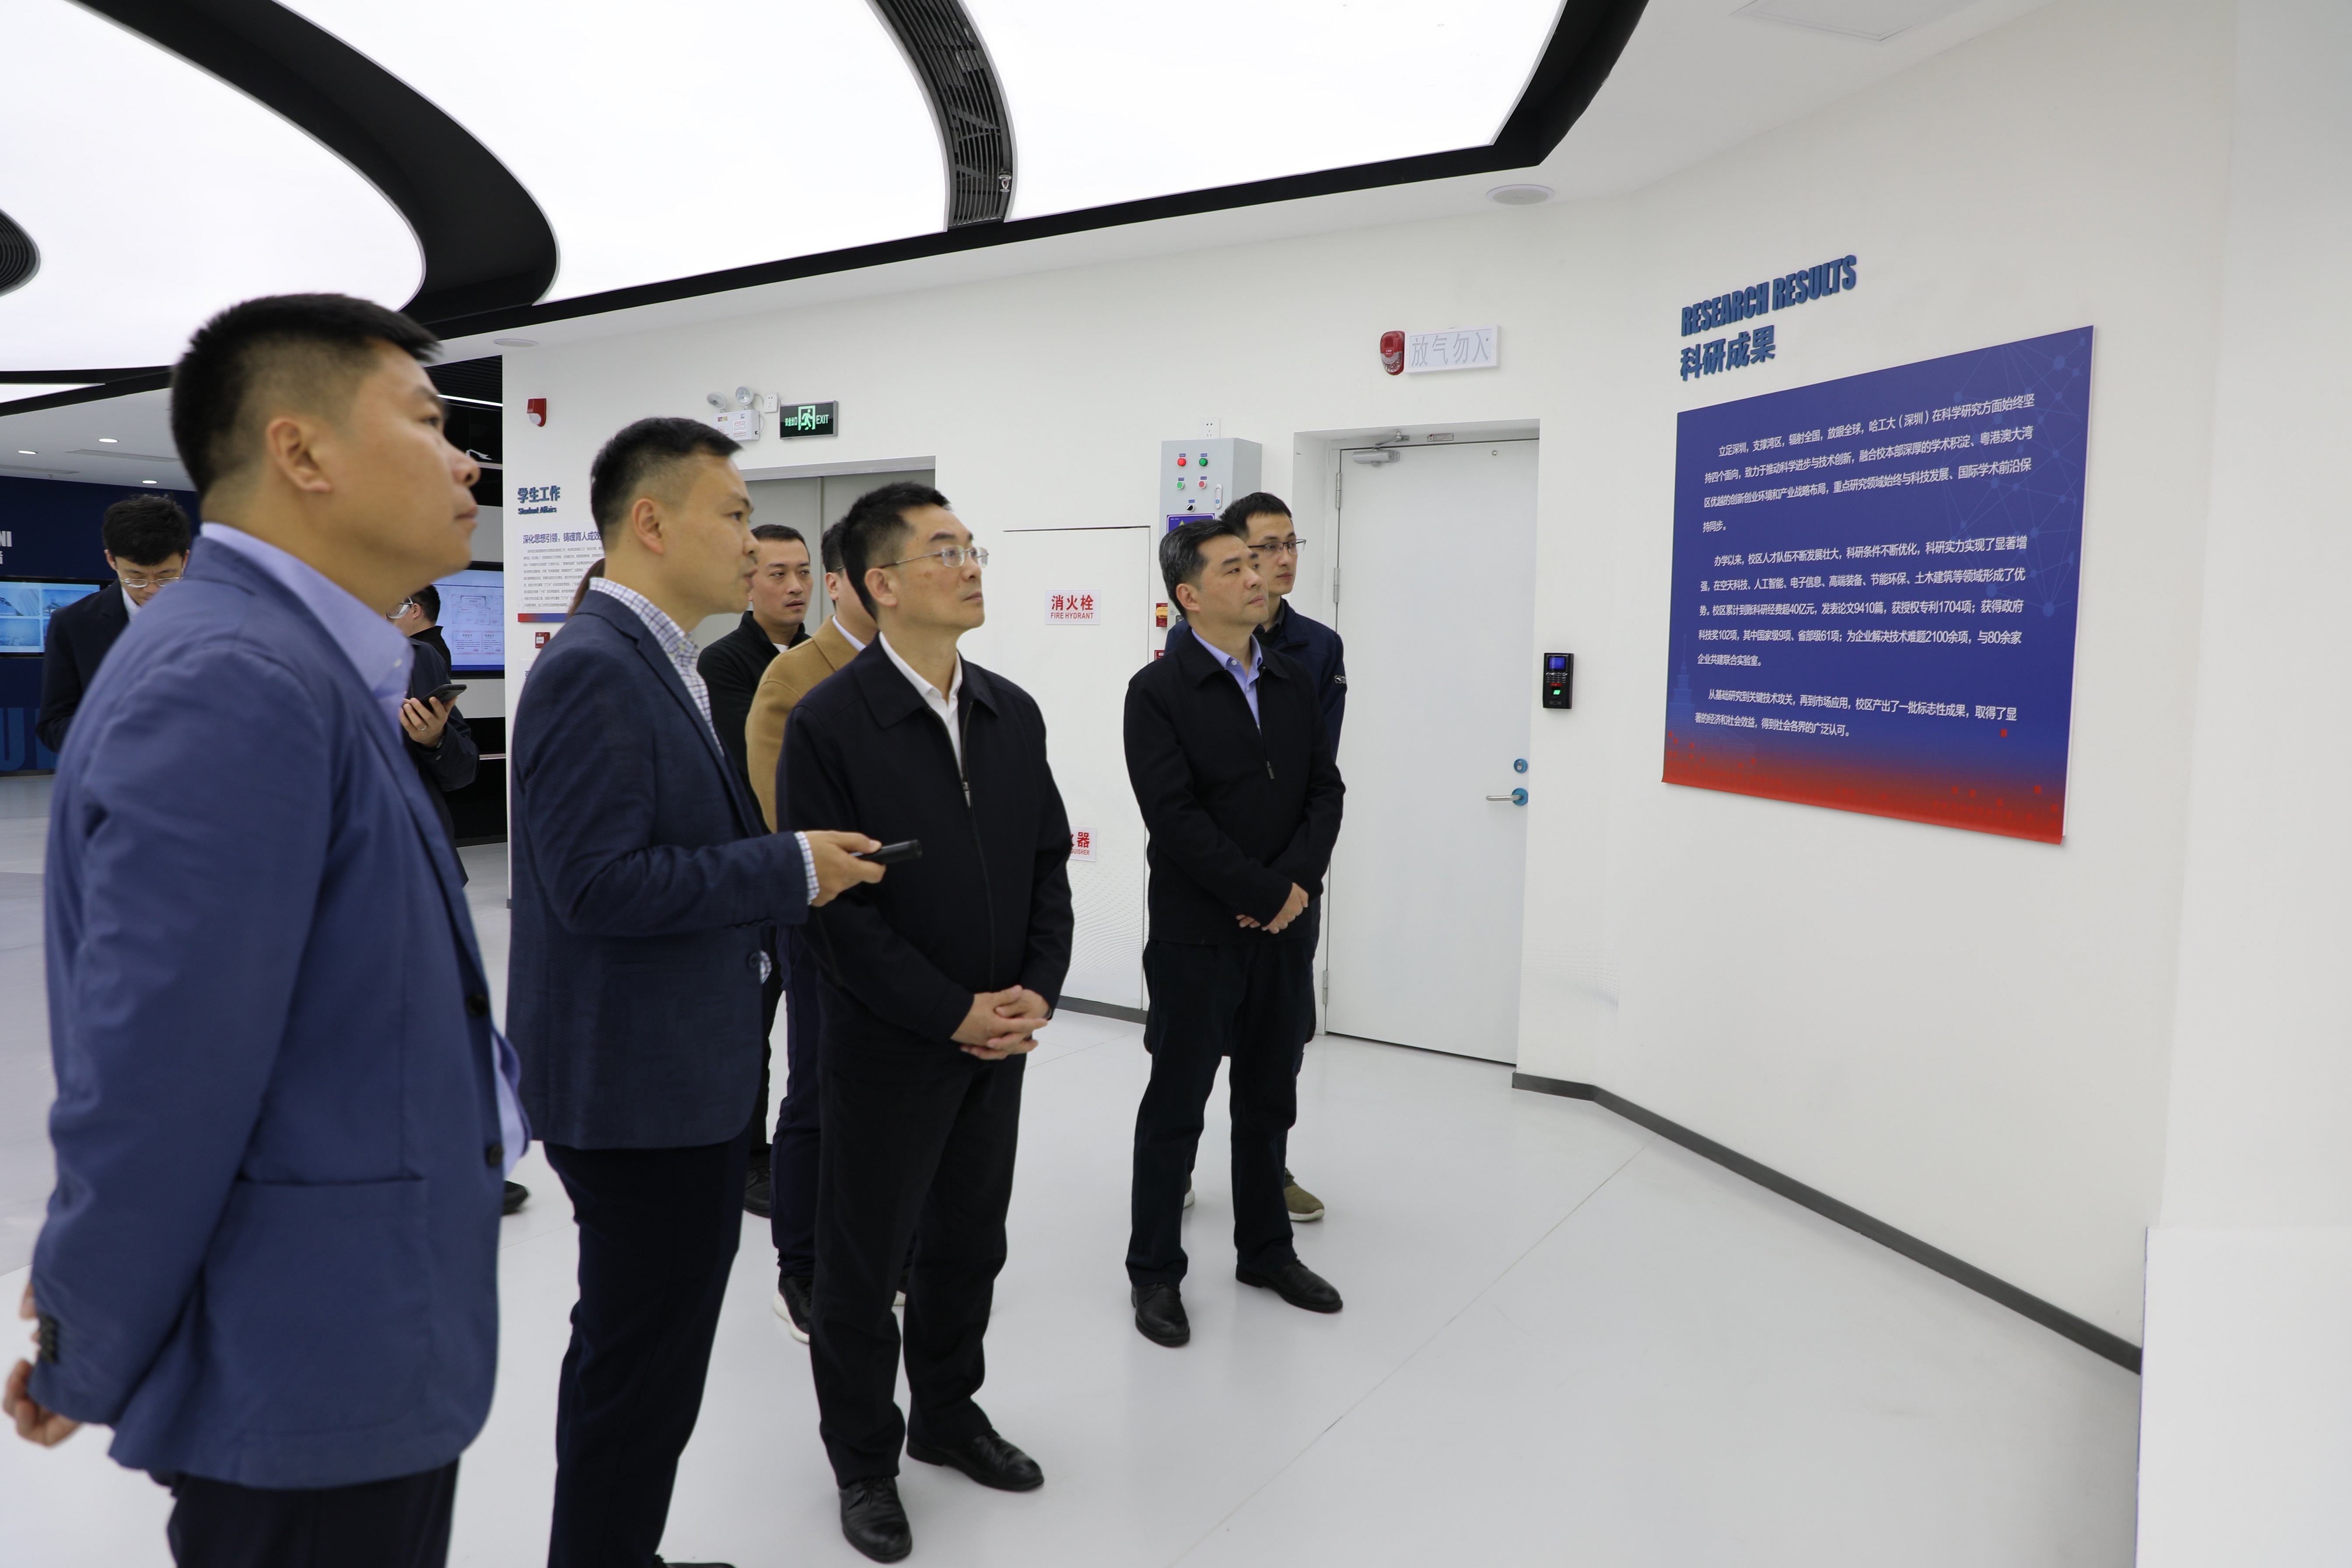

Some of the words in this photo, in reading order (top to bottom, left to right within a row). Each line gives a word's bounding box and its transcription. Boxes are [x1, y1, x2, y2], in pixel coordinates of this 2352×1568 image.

[1681, 281, 1769, 336] RESEARCH
[1772, 255, 1857, 310] RESULTS
[1411, 332, 1489, 367] 放气勿入
[1680, 325, 1775, 381] 科研成果
[816, 414, 829, 424] EXIT
[518, 485, 560, 503] 学生工作
[1703, 520, 1726, 533] 持同步。
[1051, 595, 1094, 610] 消火栓
[1698, 654, 1761, 667] 企业共建联合实验室。
[1695, 712, 1849, 737] 著的经济和社会效益，得到社会各界的广泛认可。
[1071, 832, 1090, 848] 器
